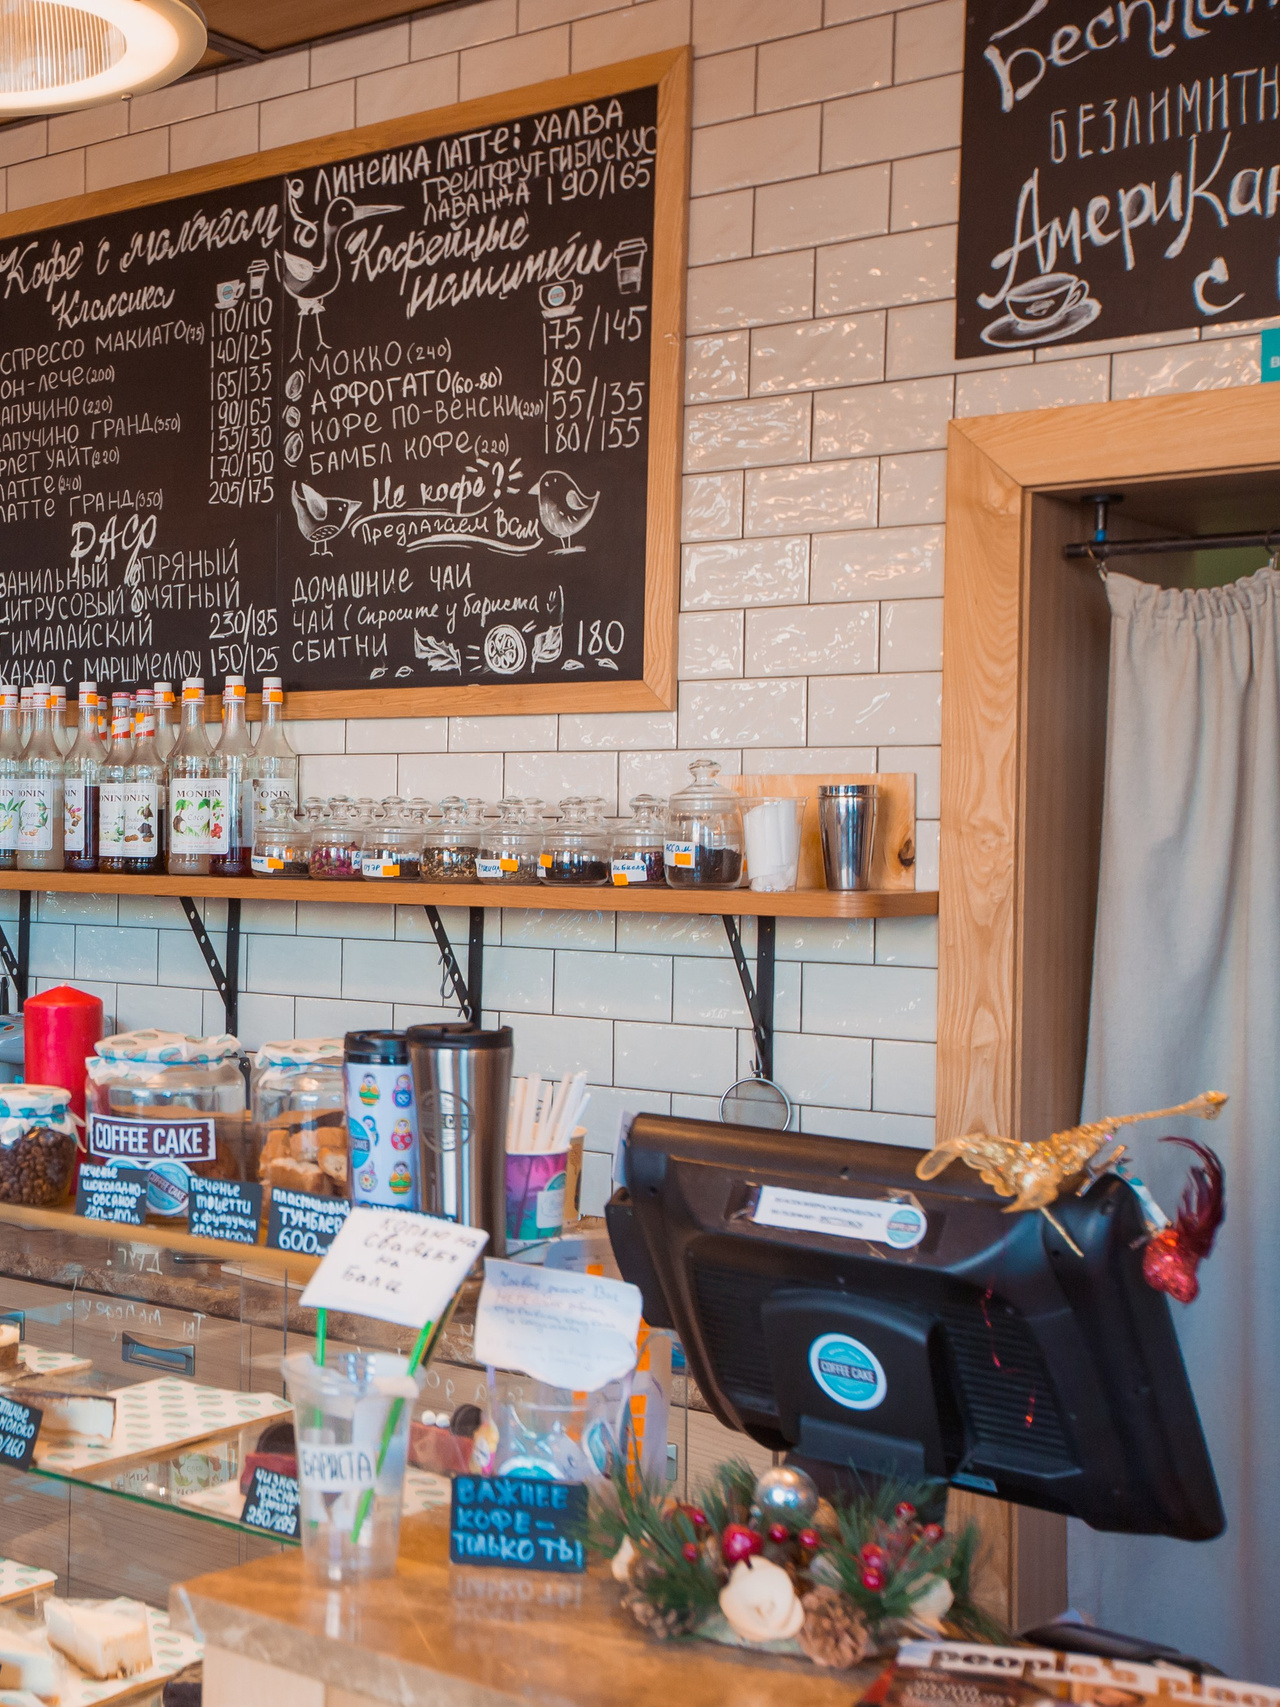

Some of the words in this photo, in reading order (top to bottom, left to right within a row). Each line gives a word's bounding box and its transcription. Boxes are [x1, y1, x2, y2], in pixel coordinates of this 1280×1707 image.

[532, 99, 624, 146] ХАЛВА
[424, 180, 531, 225] ЛАВАНДА
[548, 159, 654, 205] 190/165
[51, 285, 175, 332] Классика
[96, 320, 187, 354] МАКИАТО
[308, 341, 402, 384] МОККО
[543, 305, 648, 354] 175/145
[311, 368, 451, 415] АФФОГАТО
[544, 355, 582, 386] 180
[545, 376, 645, 423] 155/135
[91, 412, 154, 439] ГРАНД
[47, 445, 93, 472] УАЙТ
[310, 441, 393, 476] БАМБЛ
[545, 416, 643, 454] 180/155
[69, 489, 135, 517] ГРАНД
[208, 477, 274, 508] 205/175
[373, 476, 408, 512] Не
[495, 507, 540, 539] Вам
[140, 539, 239, 582] ПРЯНЫЙ
[143, 577, 240, 610] МЯТНЫЙ
[293, 605, 335, 635] ЧАЙ
[292, 633, 388, 664] СБИТНИ
[577, 619, 625, 656] 180
[20, 789, 46, 797] ONIN
[124, 794, 151, 803] ONIN
[261, 789, 291, 798] ONIN
[95, 1122, 149, 1154] COFFEE
[152, 1127, 203, 1155] CAKE
[148, 1171, 171, 1194] COFFEE
[168, 1185, 188, 1203] CAKE
[820, 1360, 851, 1378] COFFEE
[850, 1366, 876, 1384] CAKE
[456, 1474, 569, 1511] ВАЖНЕЕ
[451, 1531, 536, 1564] ТОЛЬКО
[537, 1537, 584, 1571] ТЫ
